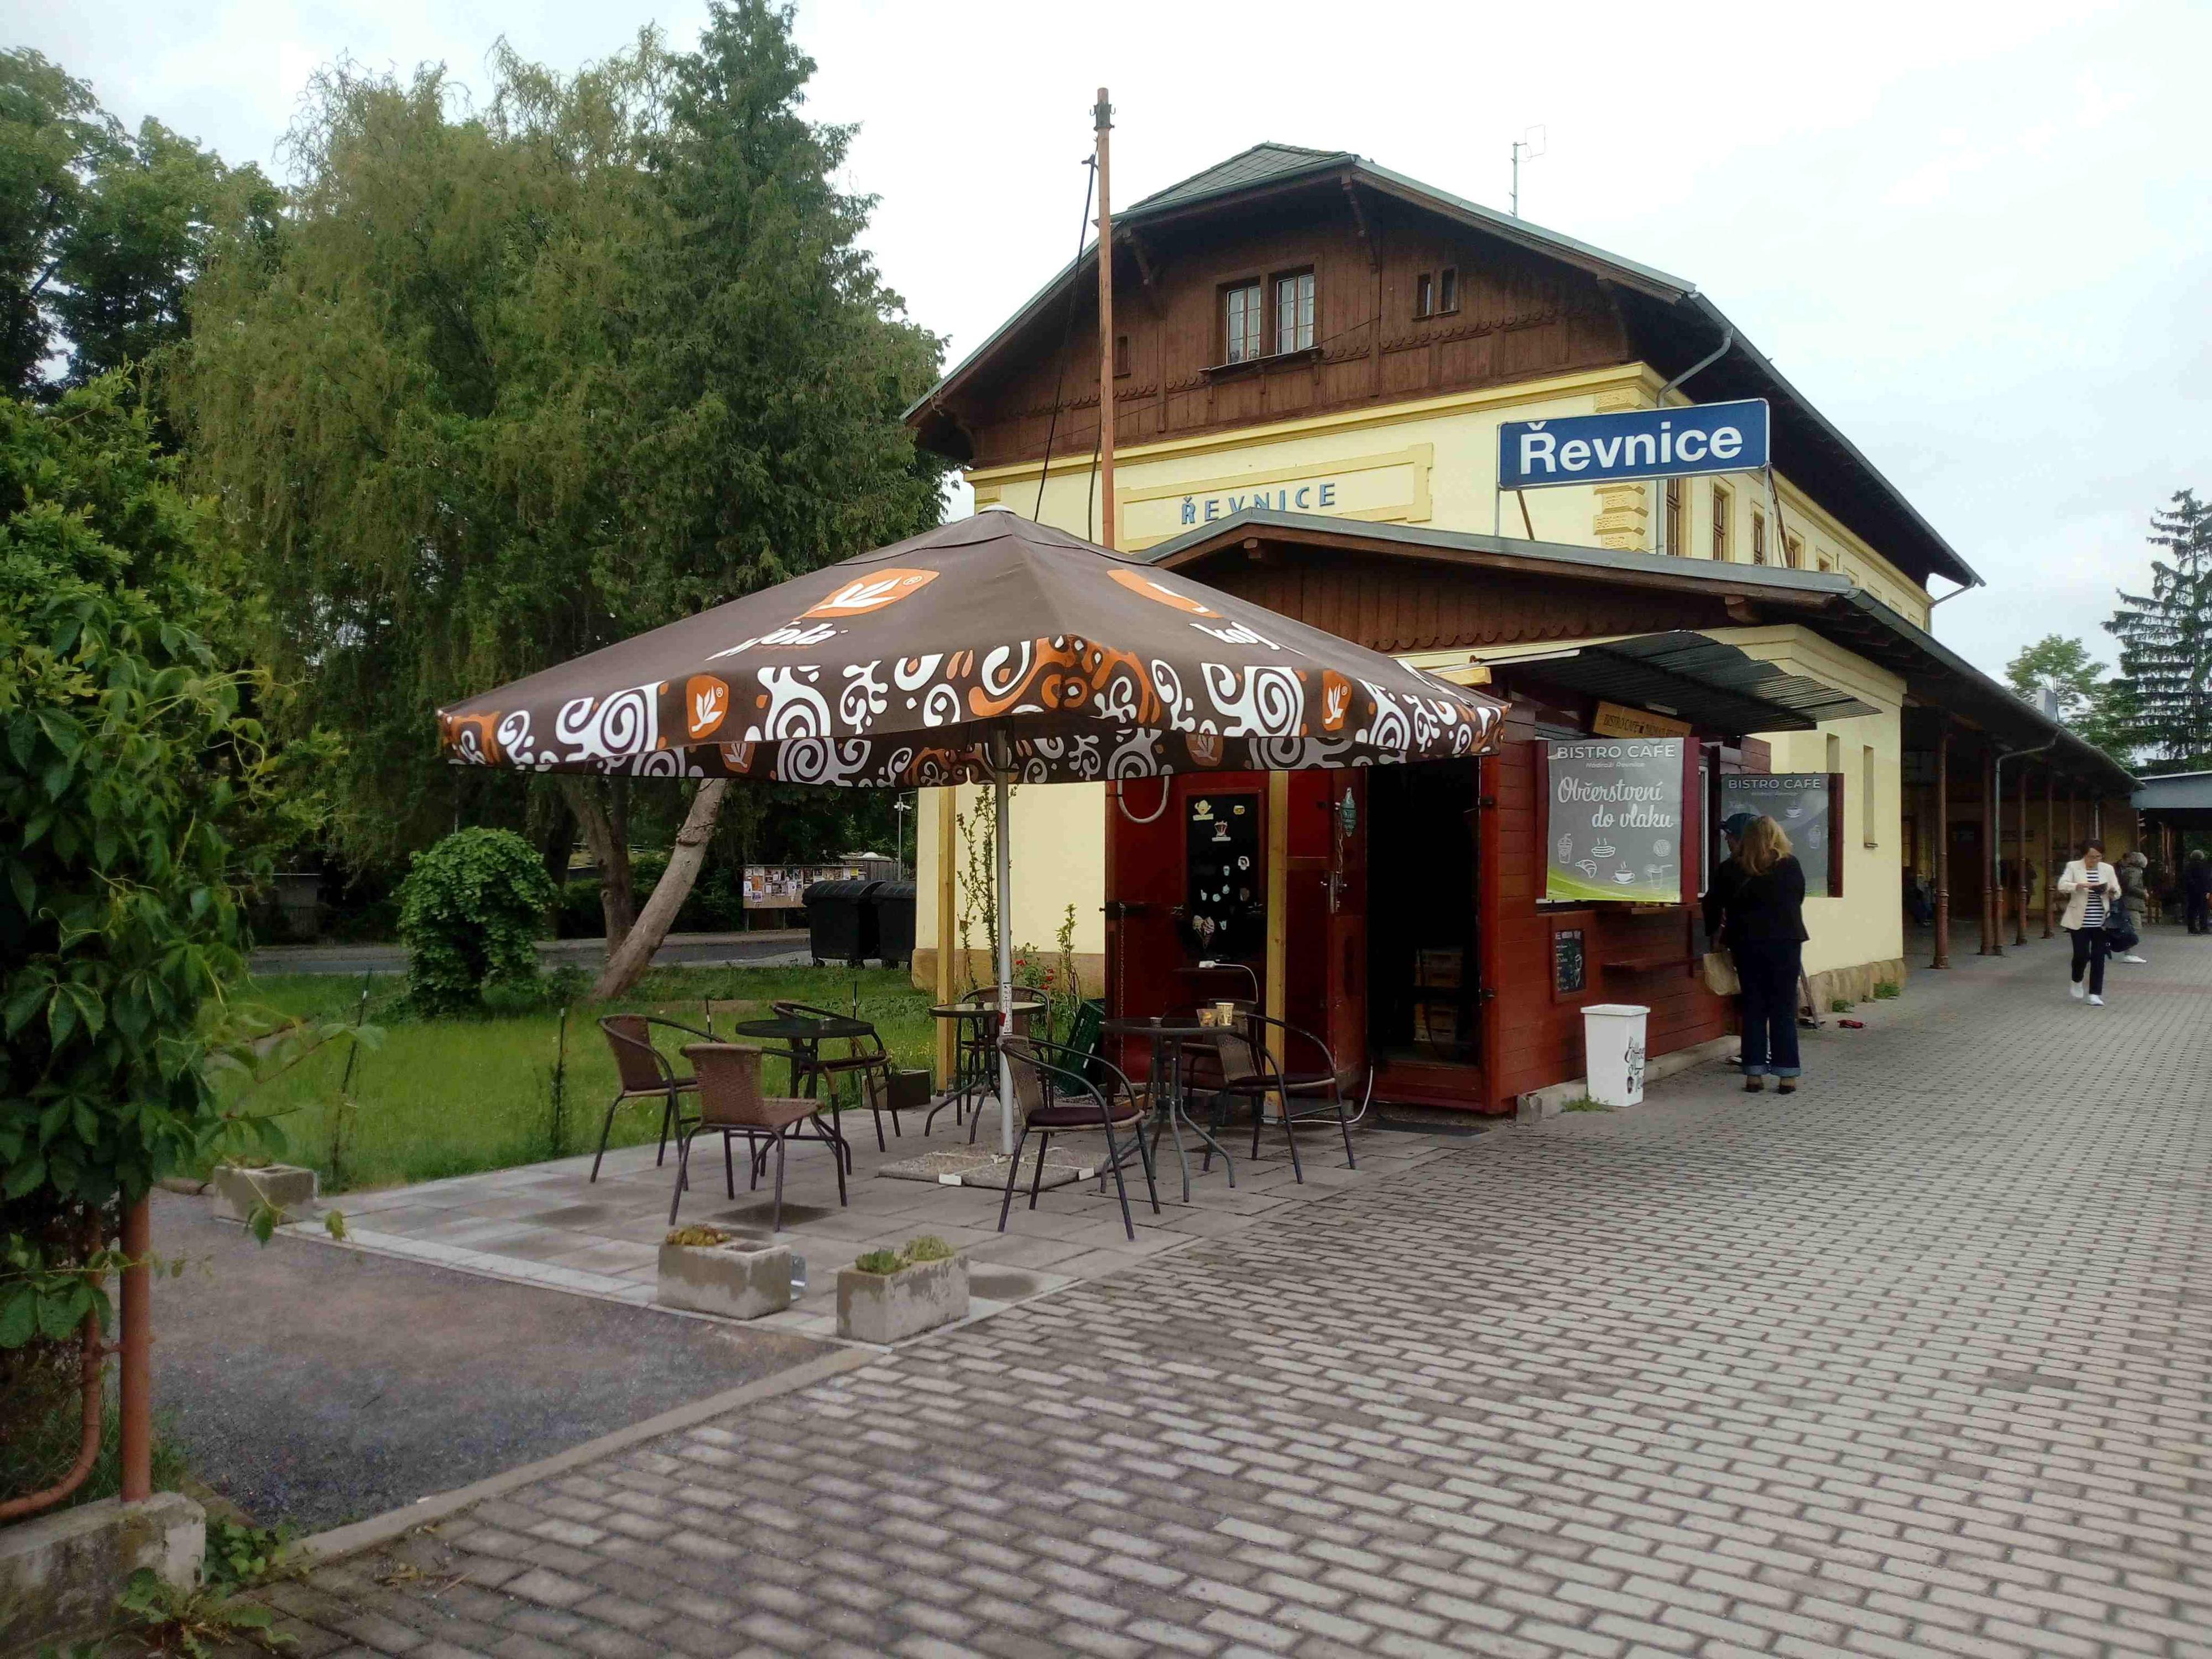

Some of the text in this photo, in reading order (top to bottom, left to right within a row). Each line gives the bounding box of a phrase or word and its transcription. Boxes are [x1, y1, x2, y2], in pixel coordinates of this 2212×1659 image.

[1520, 421, 1743, 475] Řevnice
[1181, 482, 1335, 525] ŘEVNICE
[1557, 744, 1676, 759] BISTRO CAFE
[1557, 776, 1664, 803] Občerstvení
[1728, 779, 1821, 789] BISTRO CAFE
[1591, 803, 1674, 828] do vlaku
